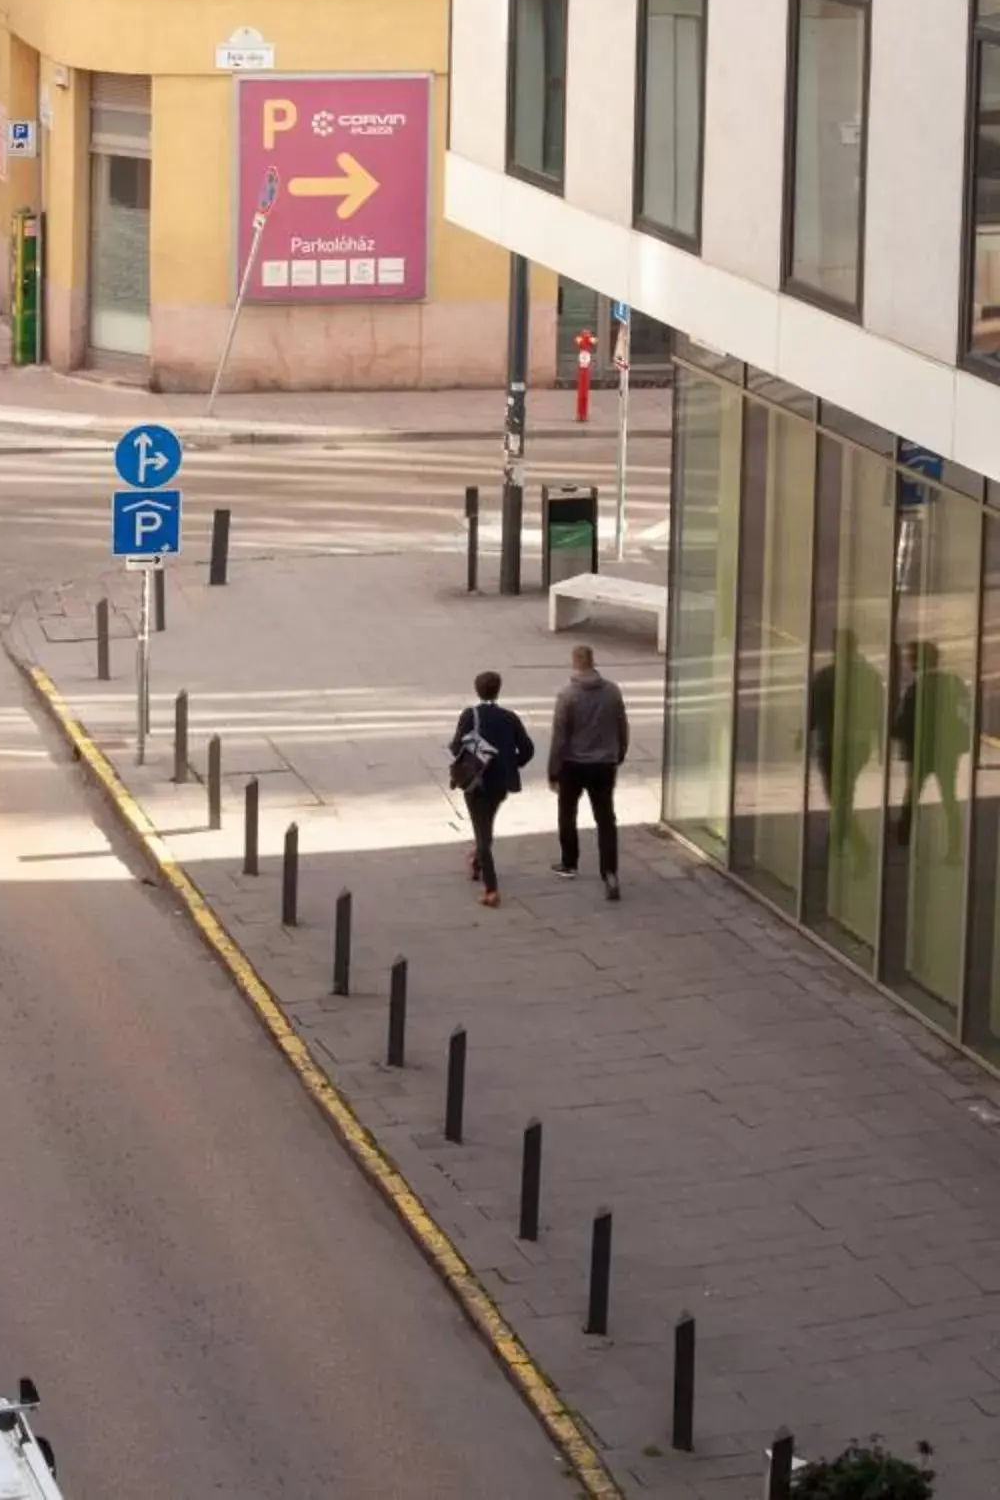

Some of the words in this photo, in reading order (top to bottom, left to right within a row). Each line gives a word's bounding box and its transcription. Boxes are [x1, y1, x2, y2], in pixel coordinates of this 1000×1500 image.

[263, 99, 297, 151] P
[338, 113, 406, 126] CORVIN
[290, 235, 375, 253] Parkolóház
[135, 511, 162, 547] P
